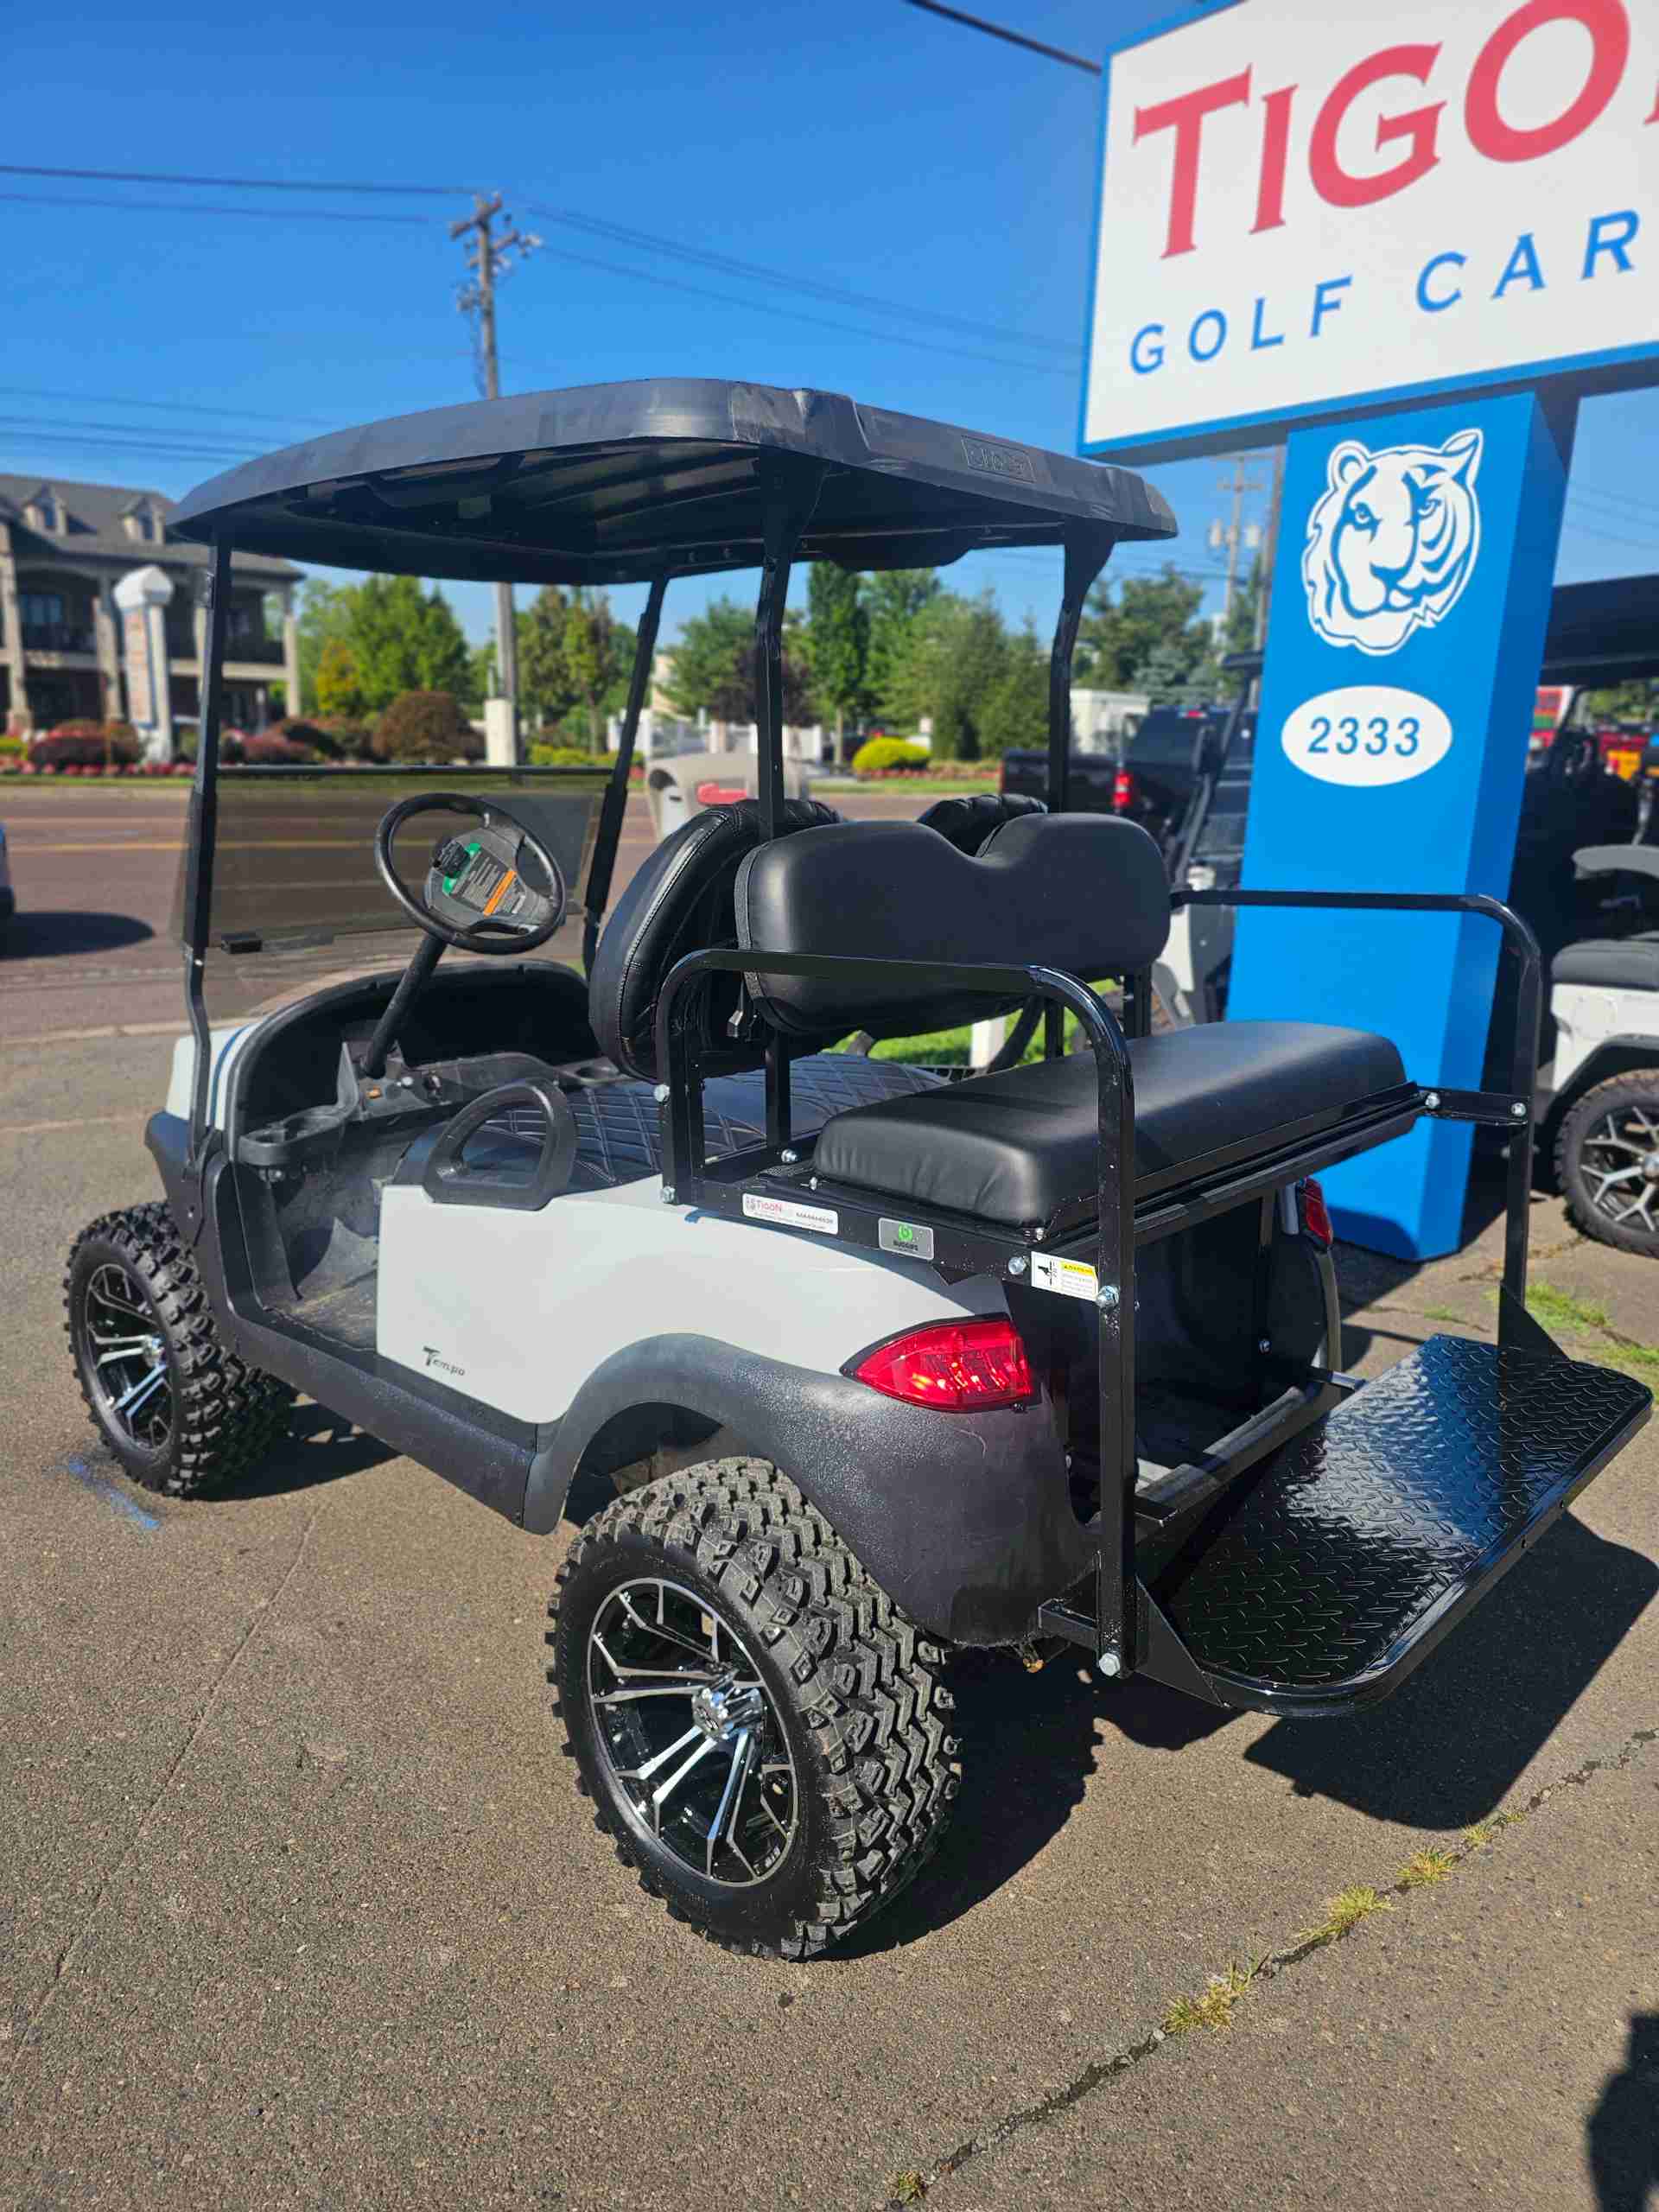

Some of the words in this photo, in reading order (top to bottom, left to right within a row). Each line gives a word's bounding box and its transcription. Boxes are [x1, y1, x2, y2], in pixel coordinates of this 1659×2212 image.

[1133, 0, 1659, 259] TIGO
[1129, 276, 1353, 375] GOLF
[1415, 210, 1640, 313] CAR
[1307, 716, 1421, 757] 2333
[423, 1346, 466, 1376] Tempo
